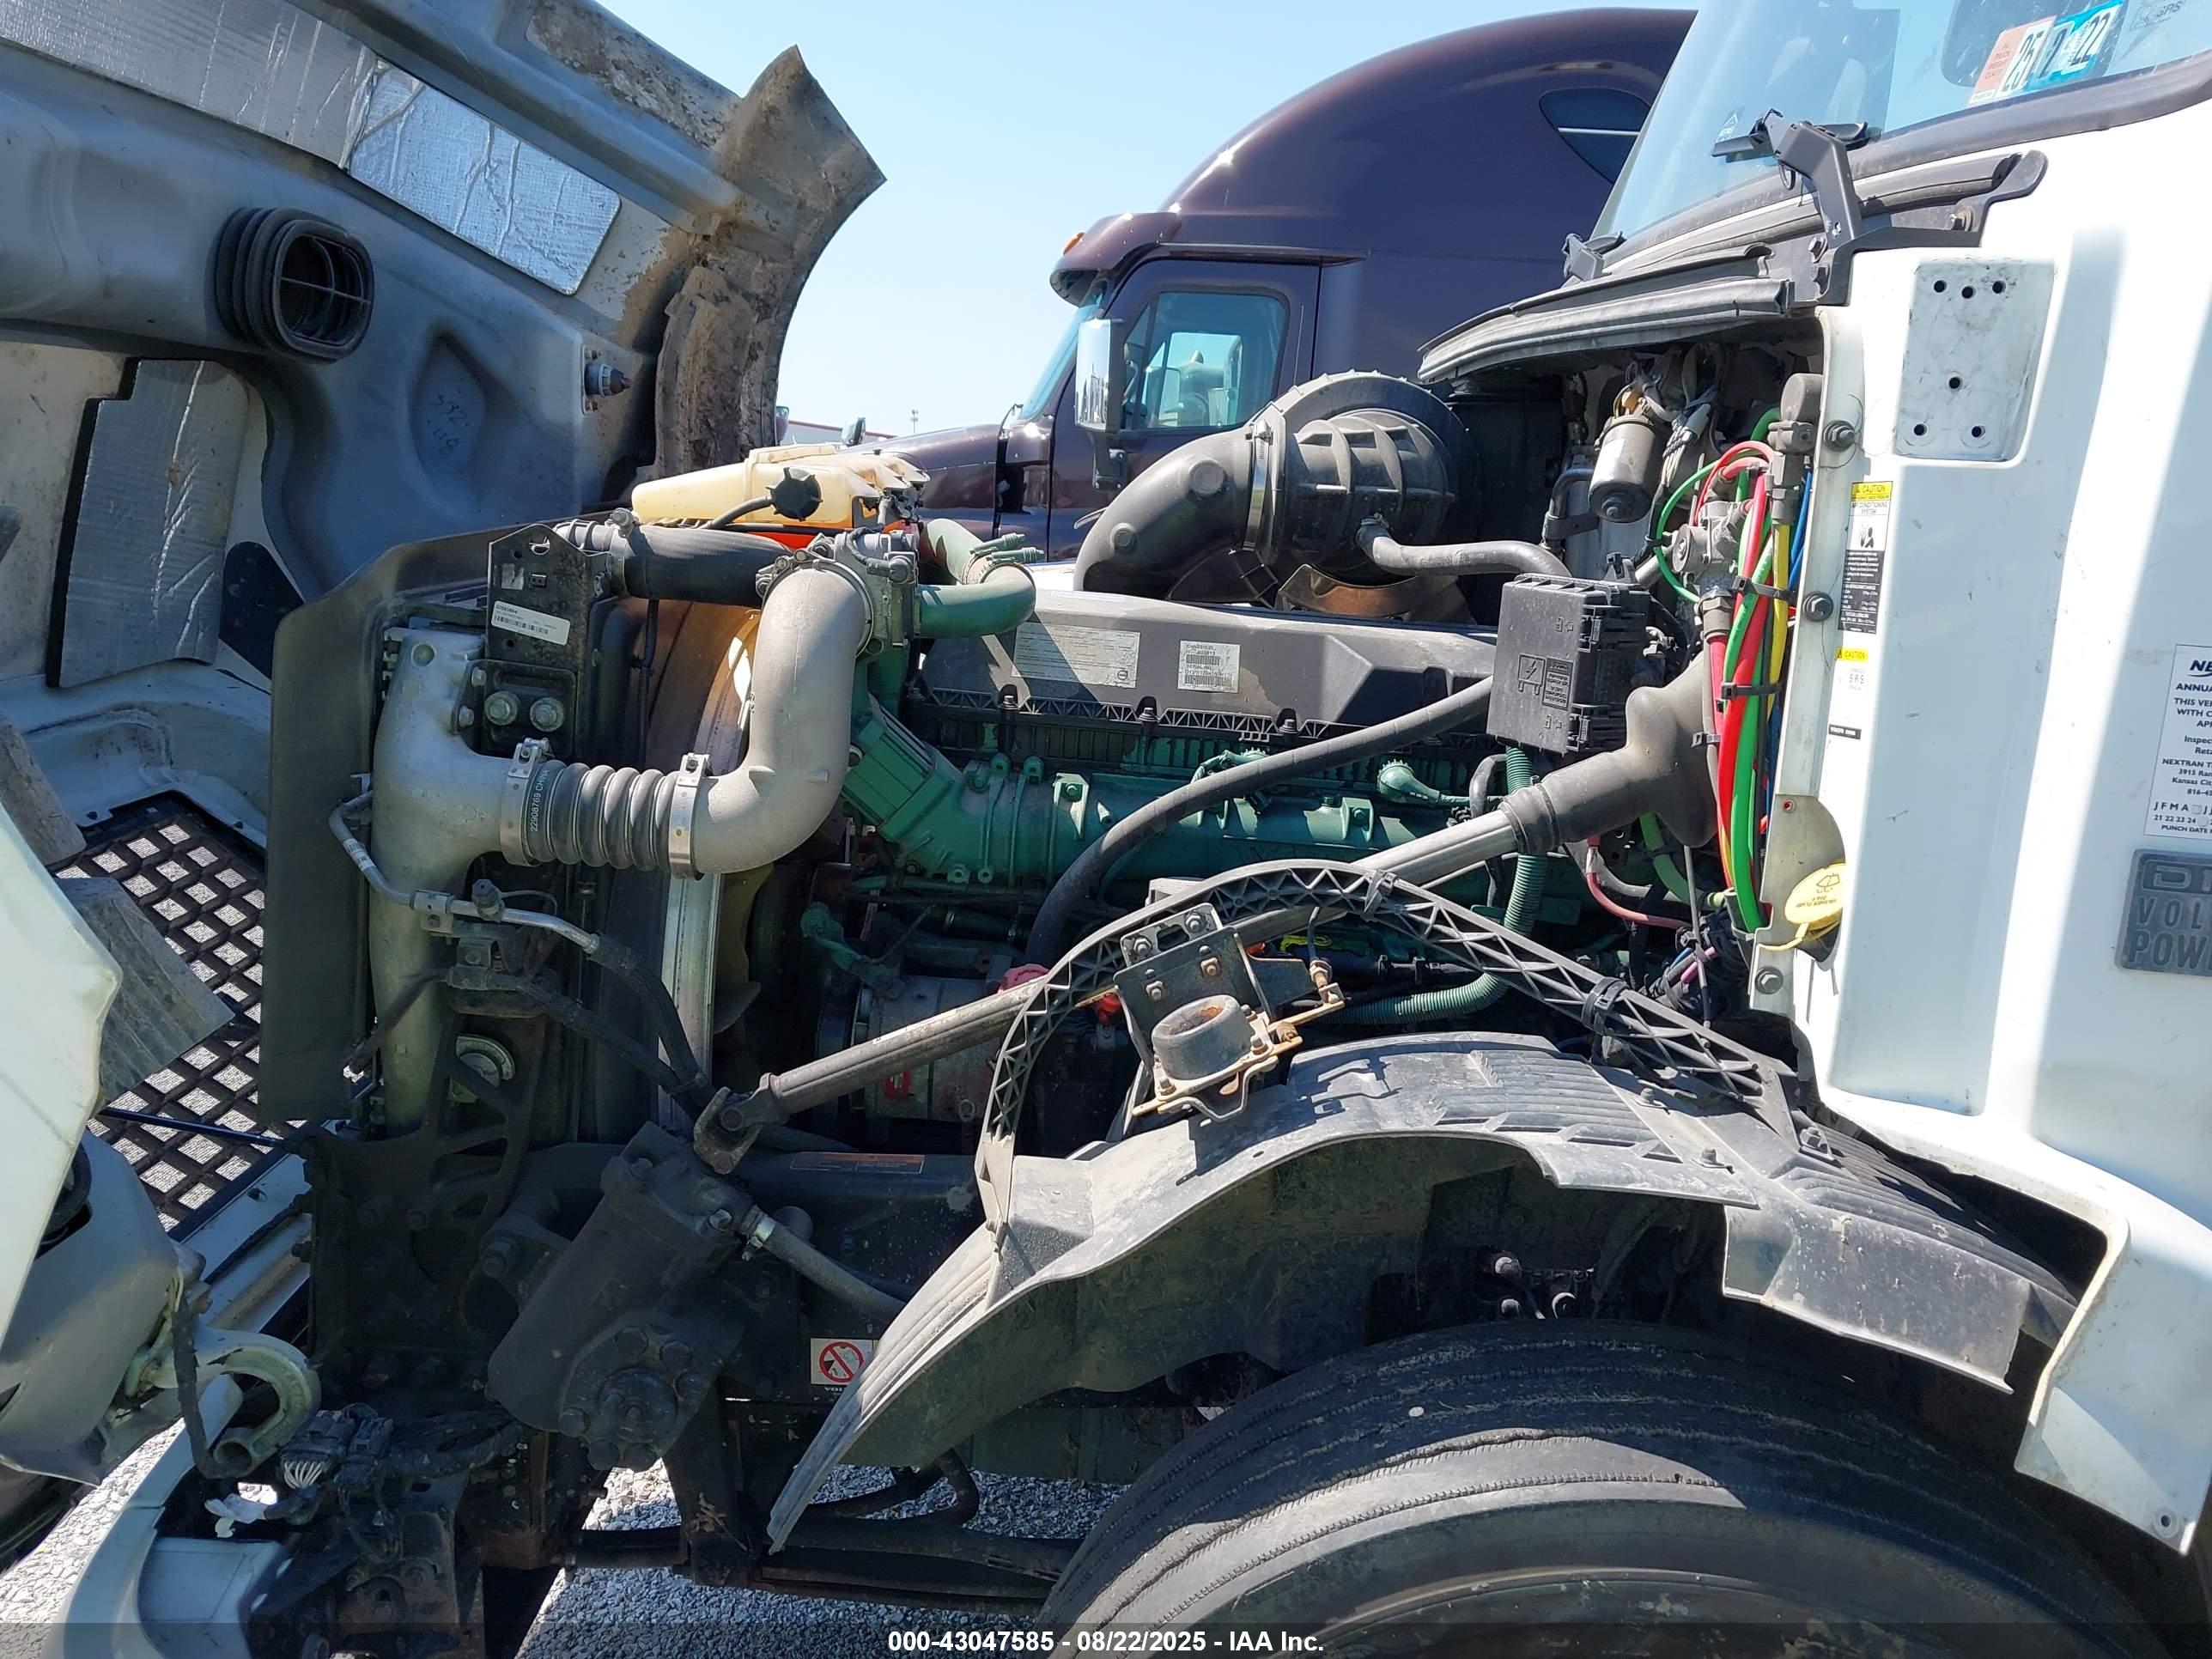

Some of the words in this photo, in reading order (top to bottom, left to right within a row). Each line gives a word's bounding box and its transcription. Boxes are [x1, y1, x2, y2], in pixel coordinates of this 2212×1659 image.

[2070, 11, 2112, 67] 22
[1862, 484, 1887, 494] CAUTION
[1844, 651, 1866, 659] CAUTION
[1849, 673, 1865, 684] SRS
[2174, 697, 2196, 706] THIS
[2177, 708, 2203, 717] WITH
[2162, 758, 2204, 768] NEXTRAN
[2172, 776, 2198, 785] Kansas
[528, 792, 544, 833] 22908769
[536, 769, 550, 792] CHINA
[2160, 801, 2167, 810] F
[2169, 802, 2179, 811] M
[2127, 930, 2212, 970] POW
